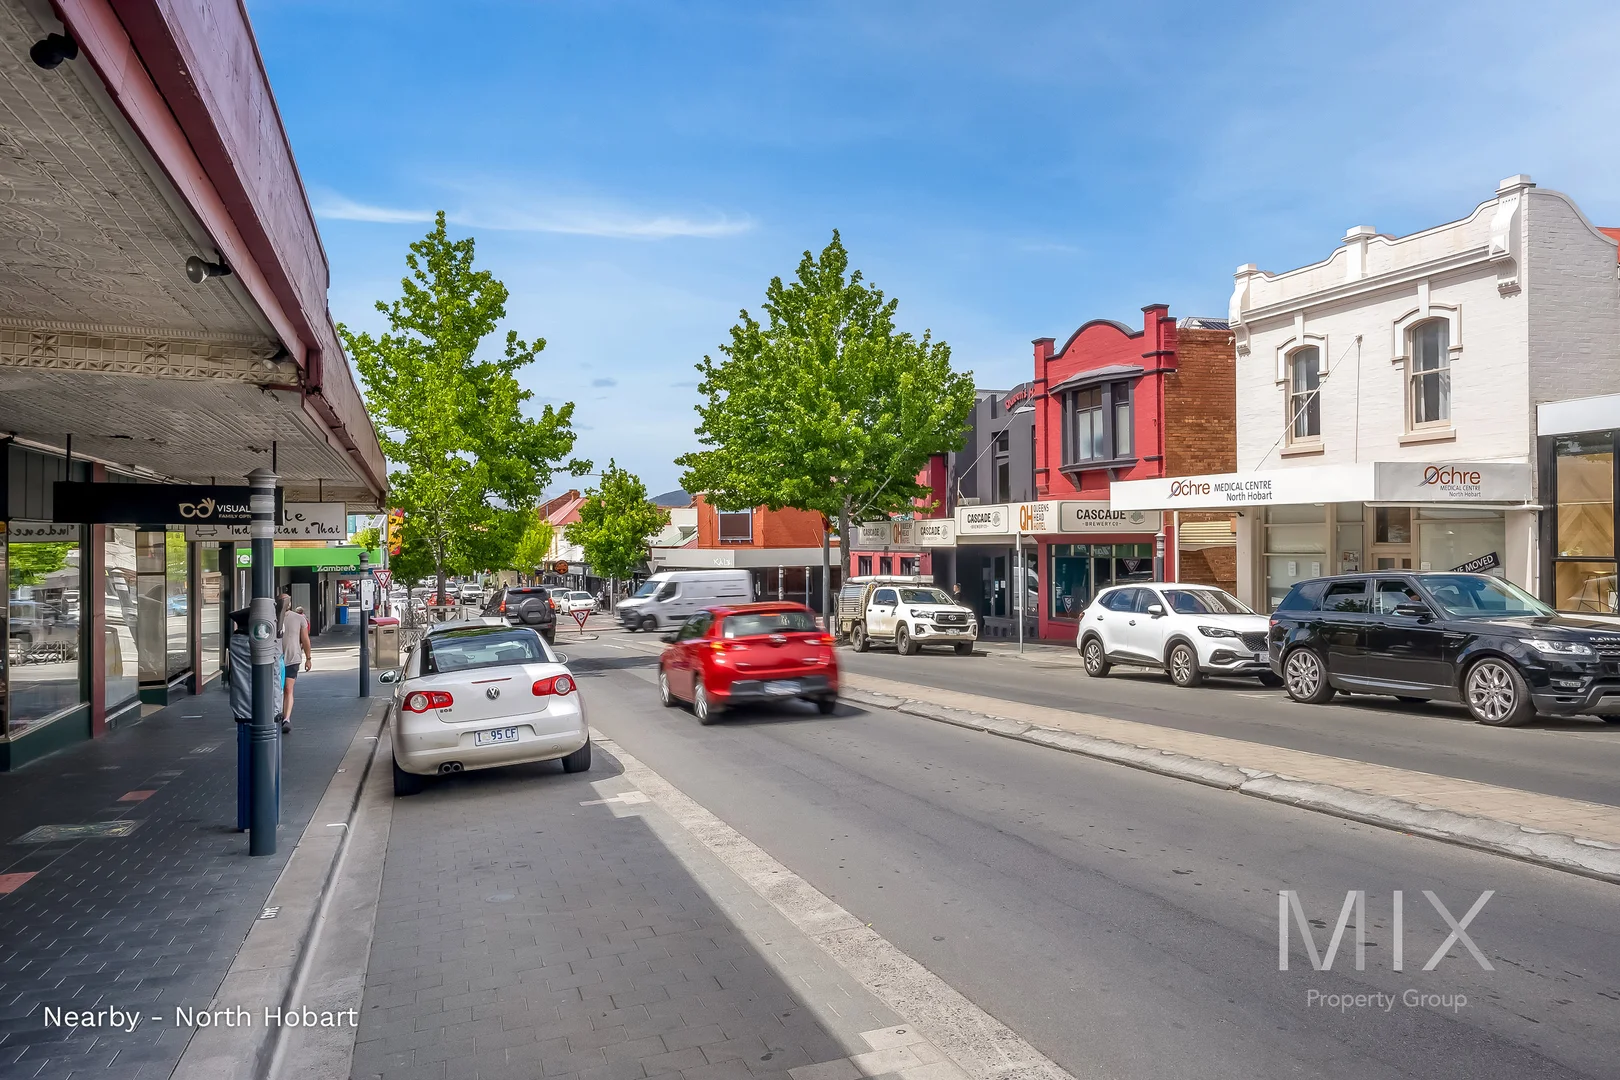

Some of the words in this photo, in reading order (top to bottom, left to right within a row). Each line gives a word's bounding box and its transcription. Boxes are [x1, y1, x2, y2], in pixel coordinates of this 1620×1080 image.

[1423, 465, 1481, 485] Ochre
[1170, 479, 1211, 497] Ochre
[1214, 481, 1243, 492] MEDICAL
[1245, 480, 1272, 491] CENTRE
[1226, 492, 1246, 501] North
[1247, 491, 1273, 501] Hobart
[216, 504, 251, 513] VISUAL
[1033, 503, 1050, 513] QUEENS
[967, 512, 992, 524] CASCADE
[1020, 504, 1033, 531] QH
[1033, 513, 1045, 522] HEAD
[1076, 509, 1127, 520] CASCADE
[304, 526, 311, 535] &
[310, 521, 341, 535] Thai
[920, 526, 941, 536] CASCADE
[1033, 521, 1047, 531] HOTEL
[1465, 555, 1494, 572] MOVED
[490, 729, 503, 741] 95
[504, 728, 516, 739] CF
